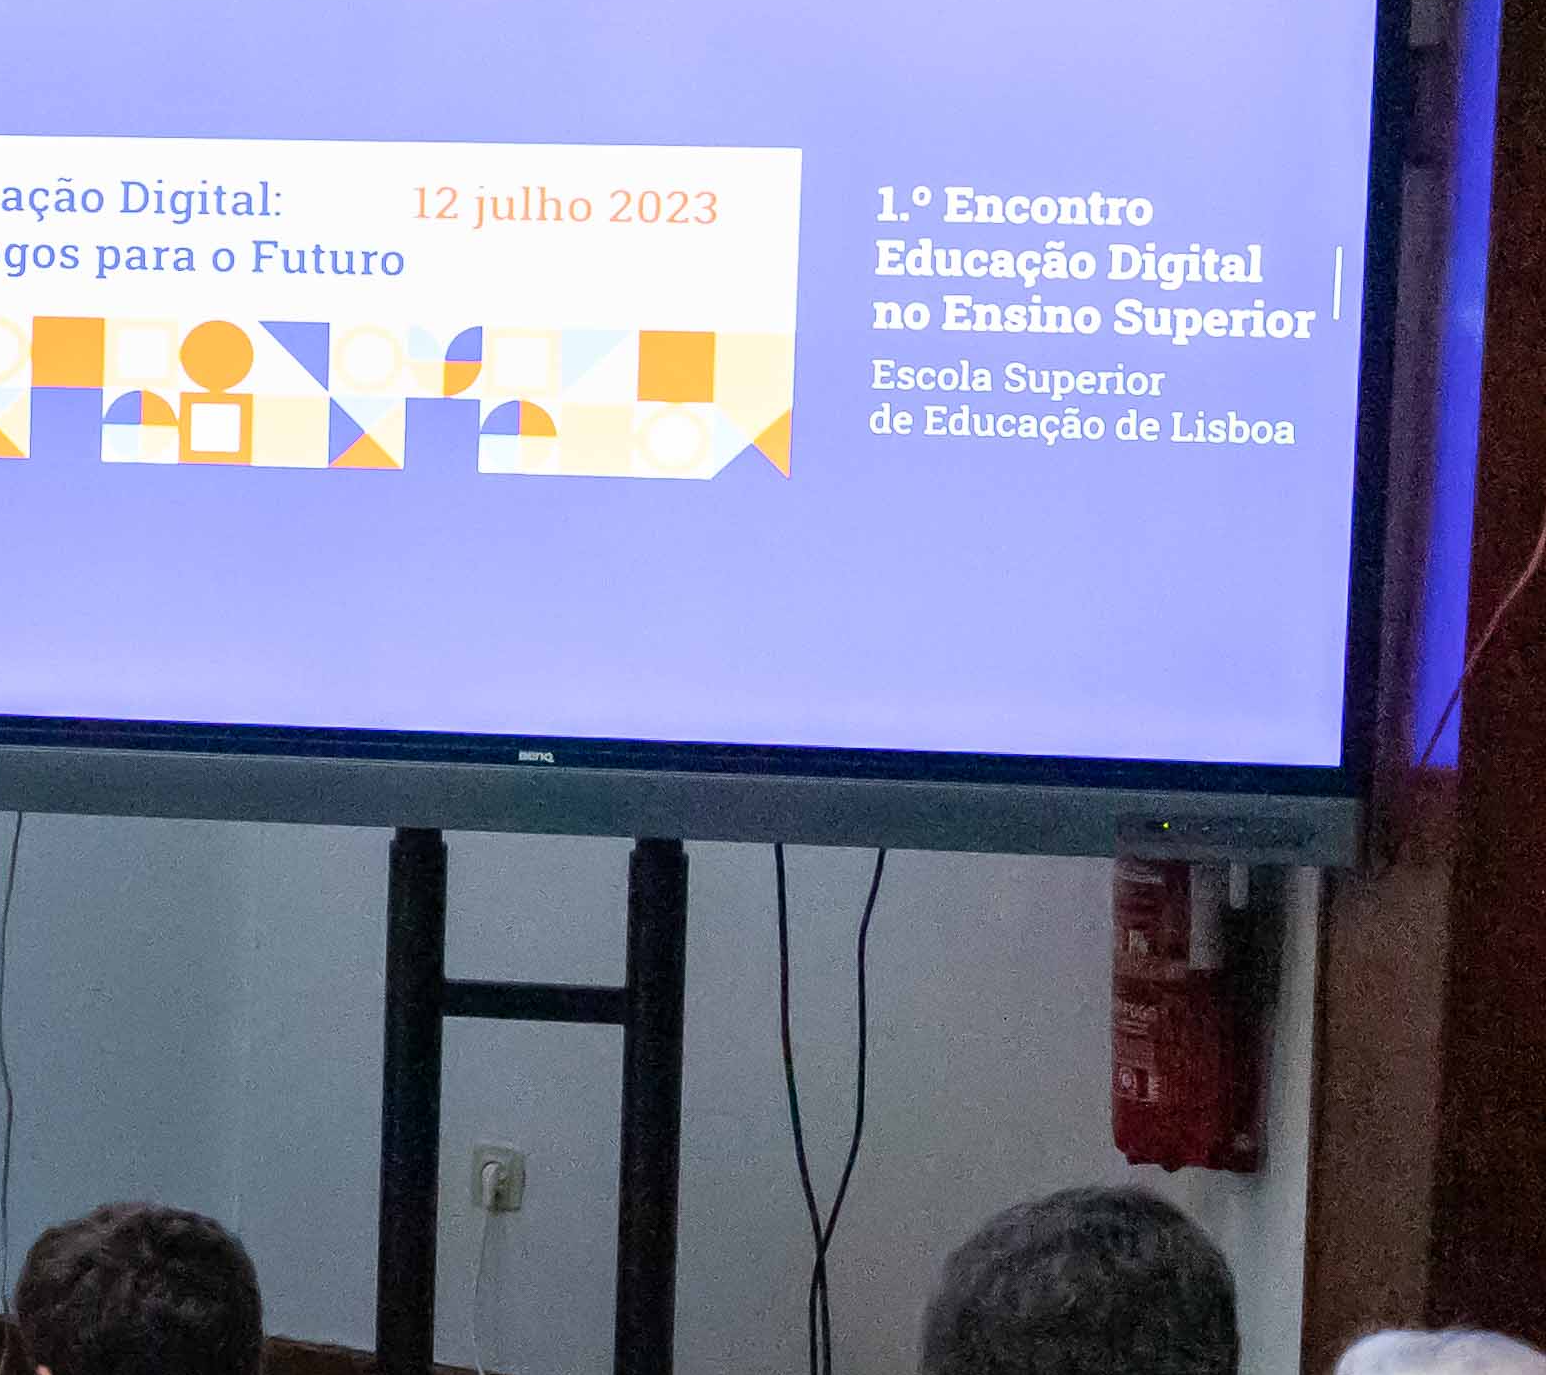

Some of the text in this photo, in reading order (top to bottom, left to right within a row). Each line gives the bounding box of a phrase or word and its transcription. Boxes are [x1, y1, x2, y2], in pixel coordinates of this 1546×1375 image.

[120, 180, 281, 224] Digital:
[416, 186, 717, 229] 12 julho 2023
[877, 186, 1153, 226] 1.º Encontro
[96, 246, 196, 279] para
[212, 248, 234, 272] o
[252, 240, 404, 276] Futuro
[875, 238, 1263, 290] Educação Digital
[873, 295, 1316, 345] no Ensino Superior
[871, 360, 1165, 402] Escola Superior
[870, 403, 1295, 445] de Educação de Lisboa
